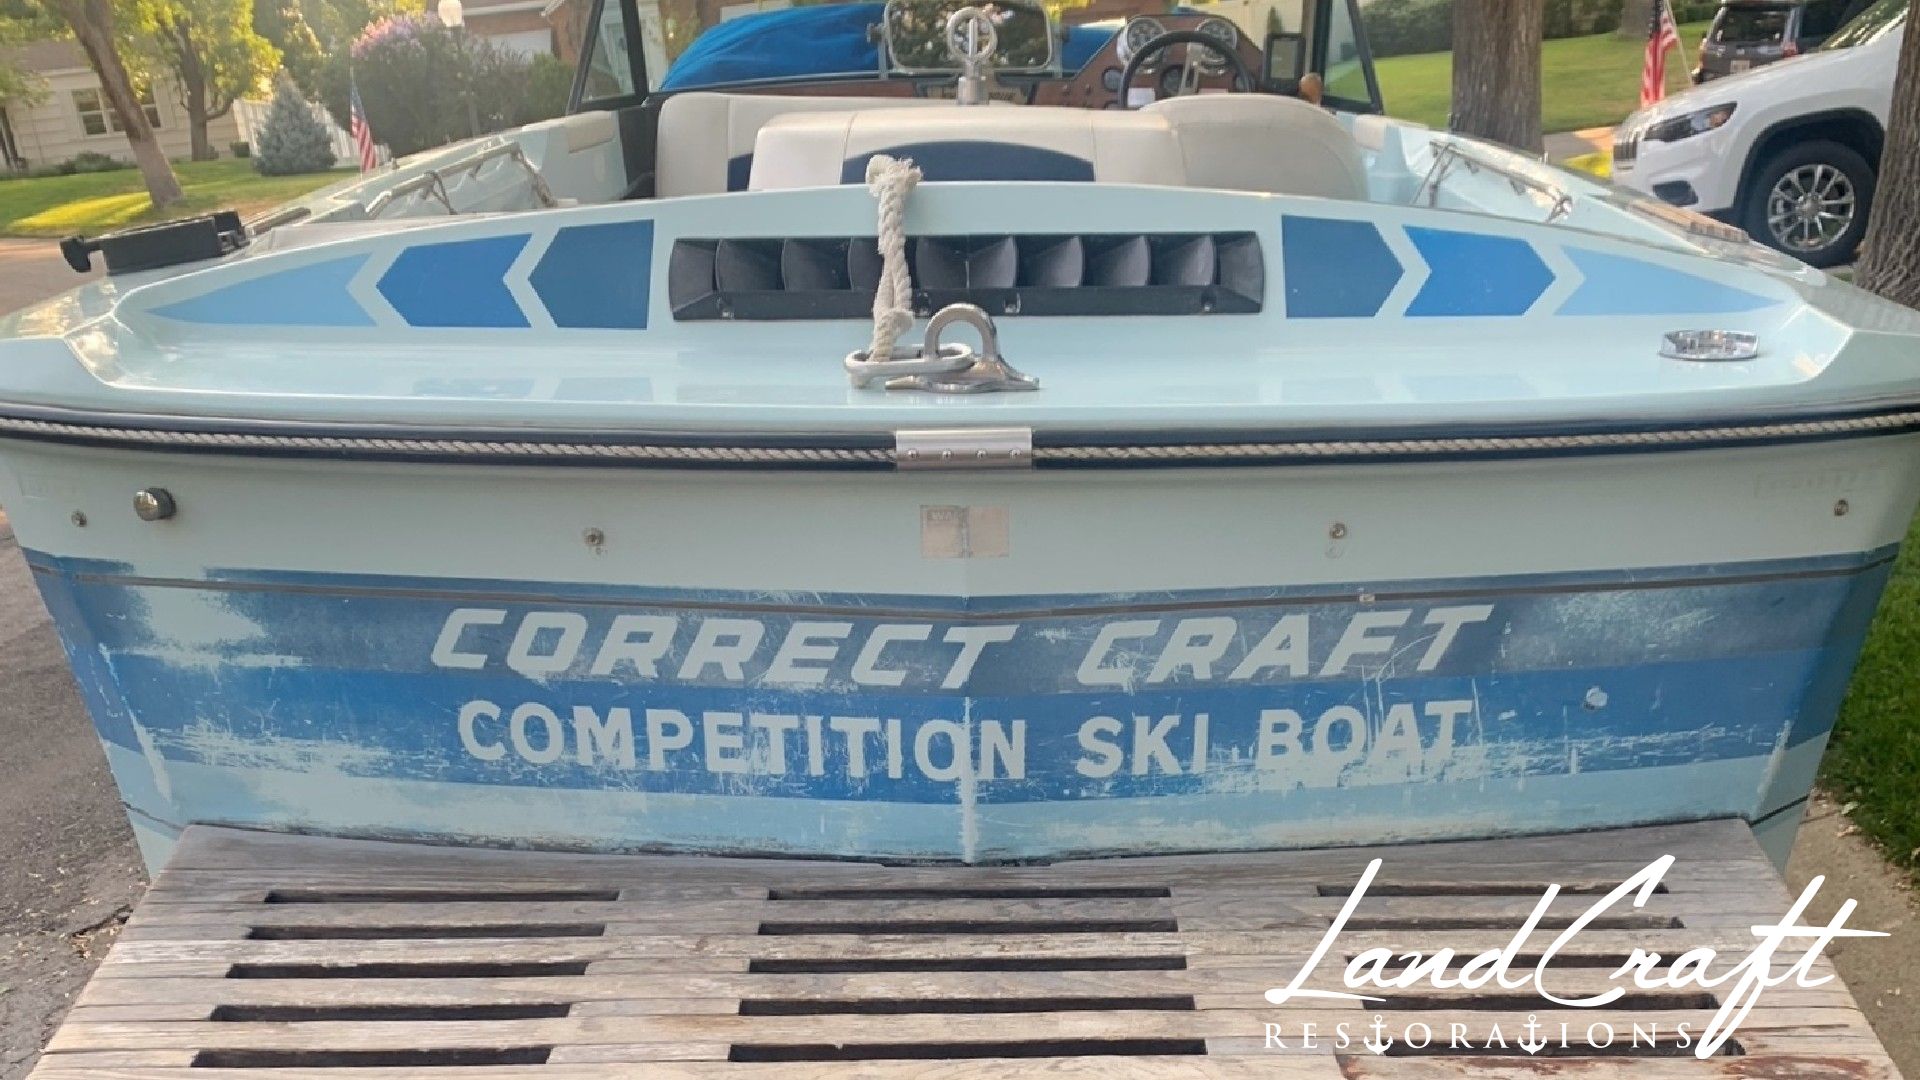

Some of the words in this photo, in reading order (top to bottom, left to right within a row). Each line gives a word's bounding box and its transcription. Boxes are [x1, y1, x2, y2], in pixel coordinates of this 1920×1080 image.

[431, 607, 1019, 689] CORRECT
[1076, 604, 1495, 686] CRAFT
[457, 700, 1026, 782] COMPETITION
[1075, 713, 1210, 778] SKI
[1256, 700, 1473, 776] BOAT
